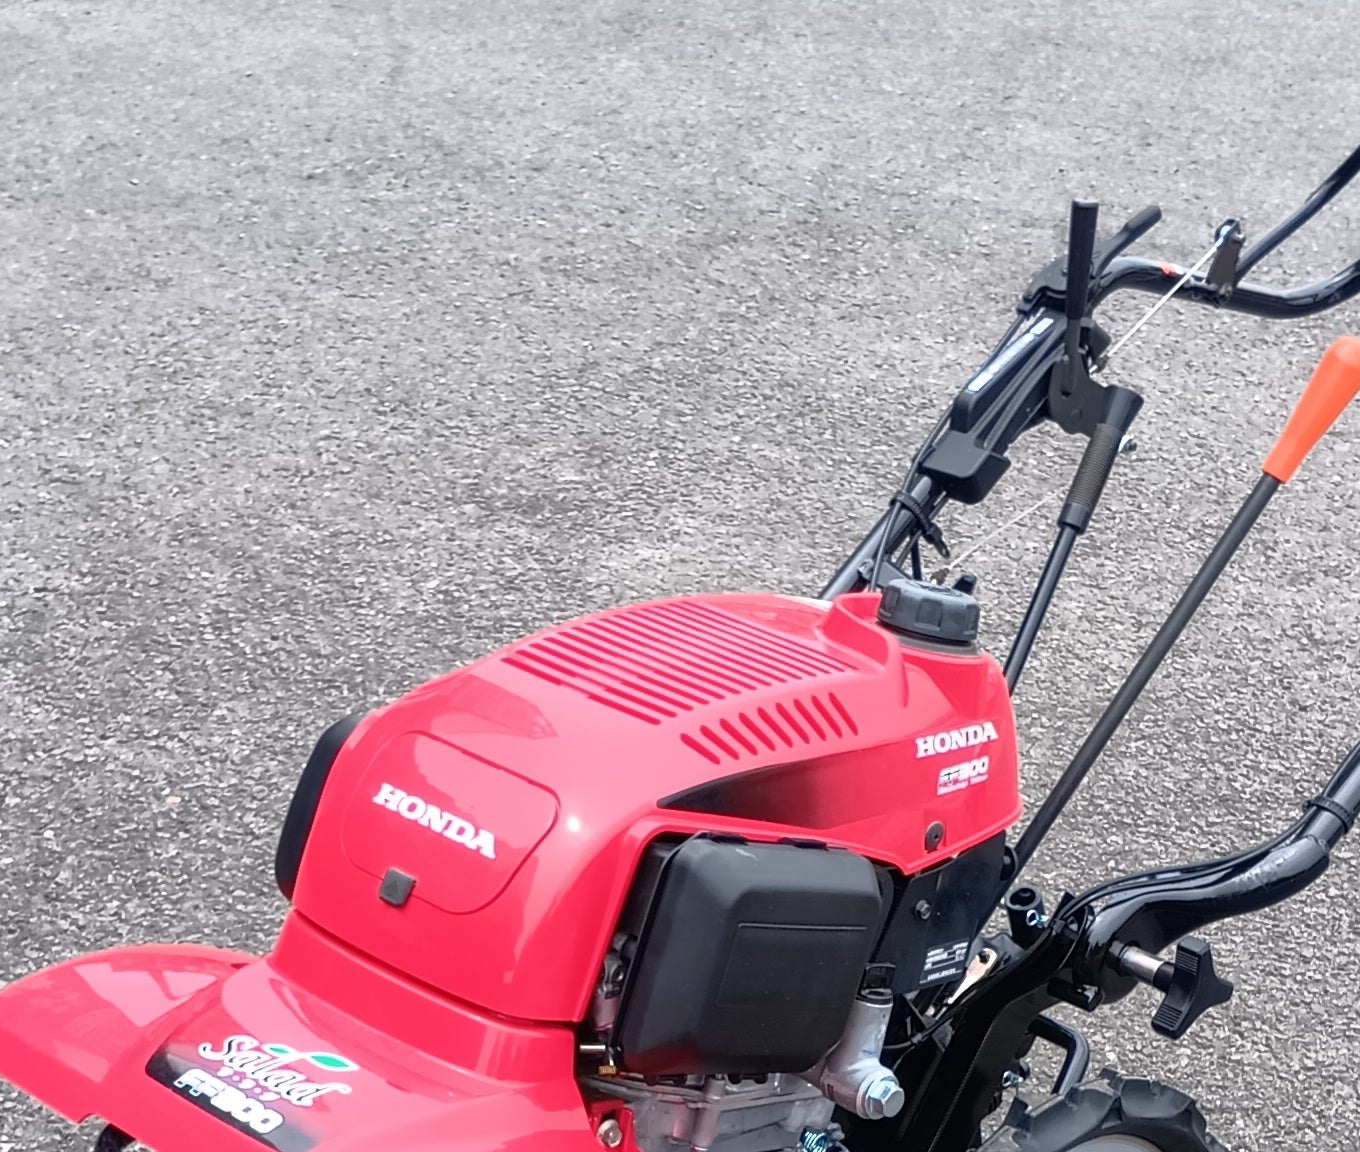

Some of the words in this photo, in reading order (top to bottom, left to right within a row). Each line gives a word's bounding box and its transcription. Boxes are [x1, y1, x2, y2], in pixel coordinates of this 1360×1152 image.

[915, 721, 999, 759] HONDA
[372, 782, 496, 860] HONDA
[198, 1034, 353, 1108] Salad
